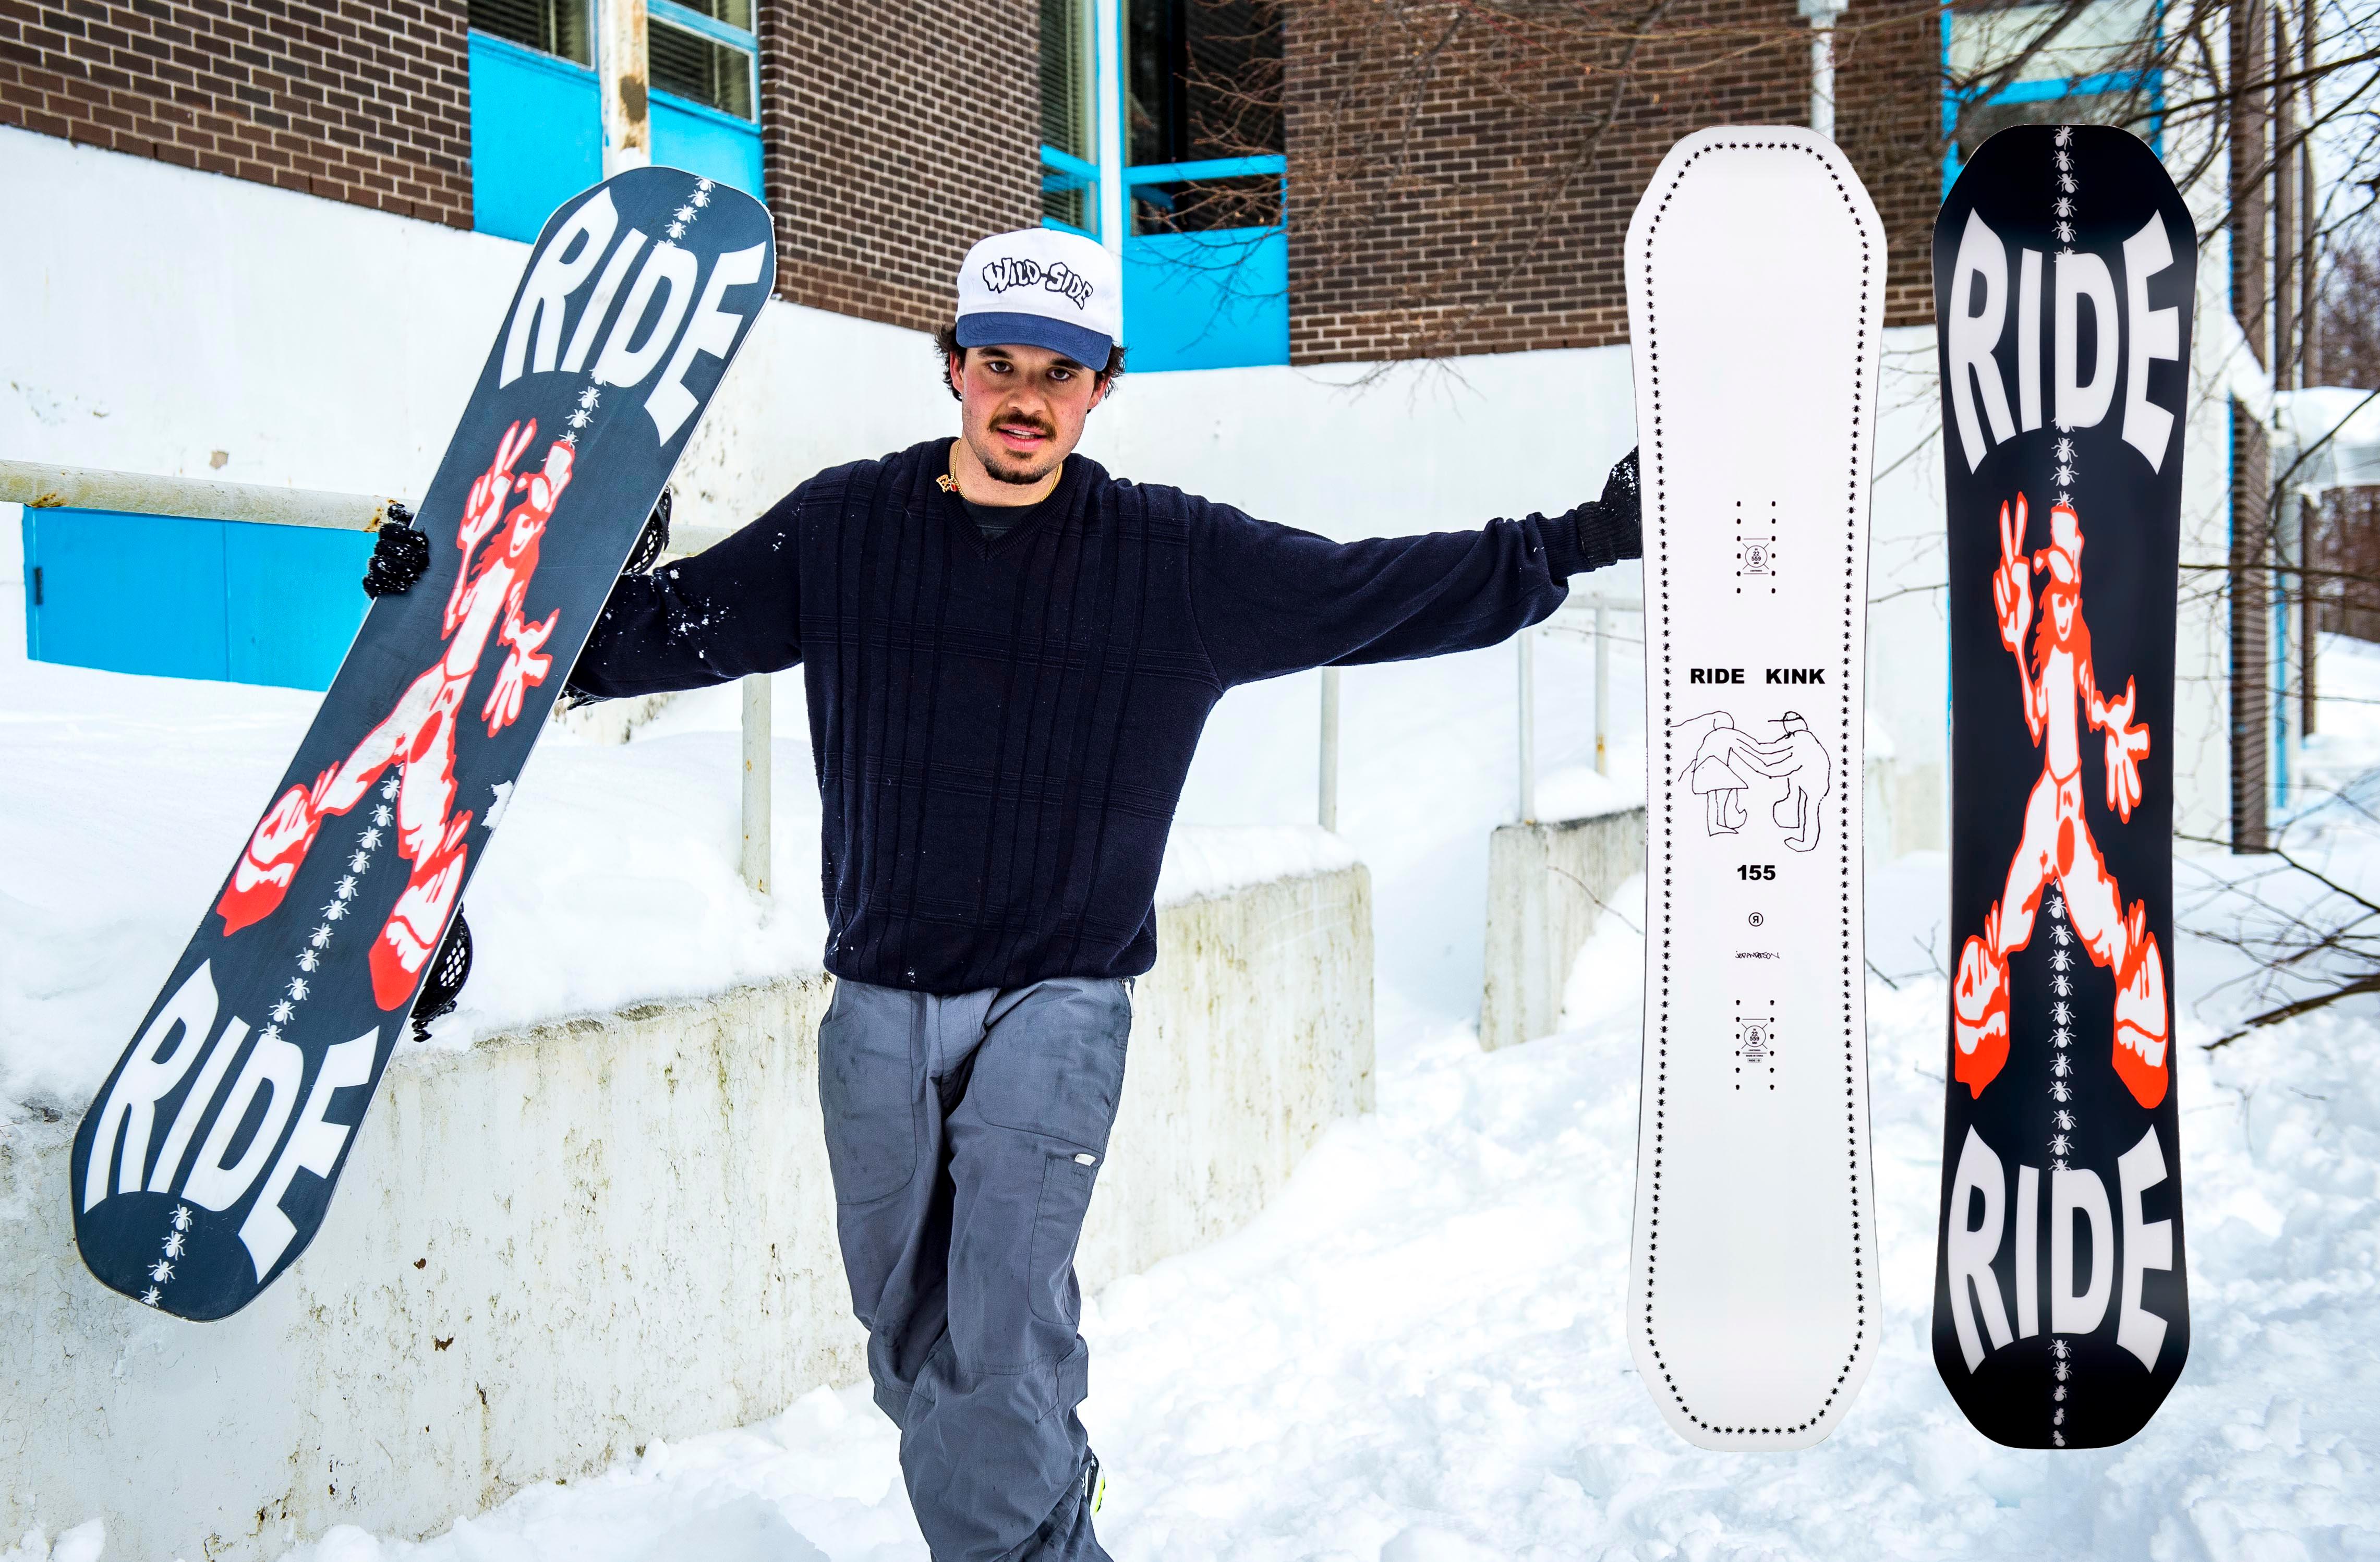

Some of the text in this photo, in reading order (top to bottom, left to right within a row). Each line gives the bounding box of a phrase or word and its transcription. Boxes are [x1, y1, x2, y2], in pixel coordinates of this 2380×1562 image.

[499, 186, 766, 447] RIDE
[982, 257, 1094, 310] WILD-SIDE
[1948, 207, 2180, 476] RIDE
[1690, 668, 1826, 684] RIDE KINK
[1737, 864, 1776, 881] 155
[84, 958, 380, 1285] RIDE
[1948, 1123, 2173, 1375] RIDE
